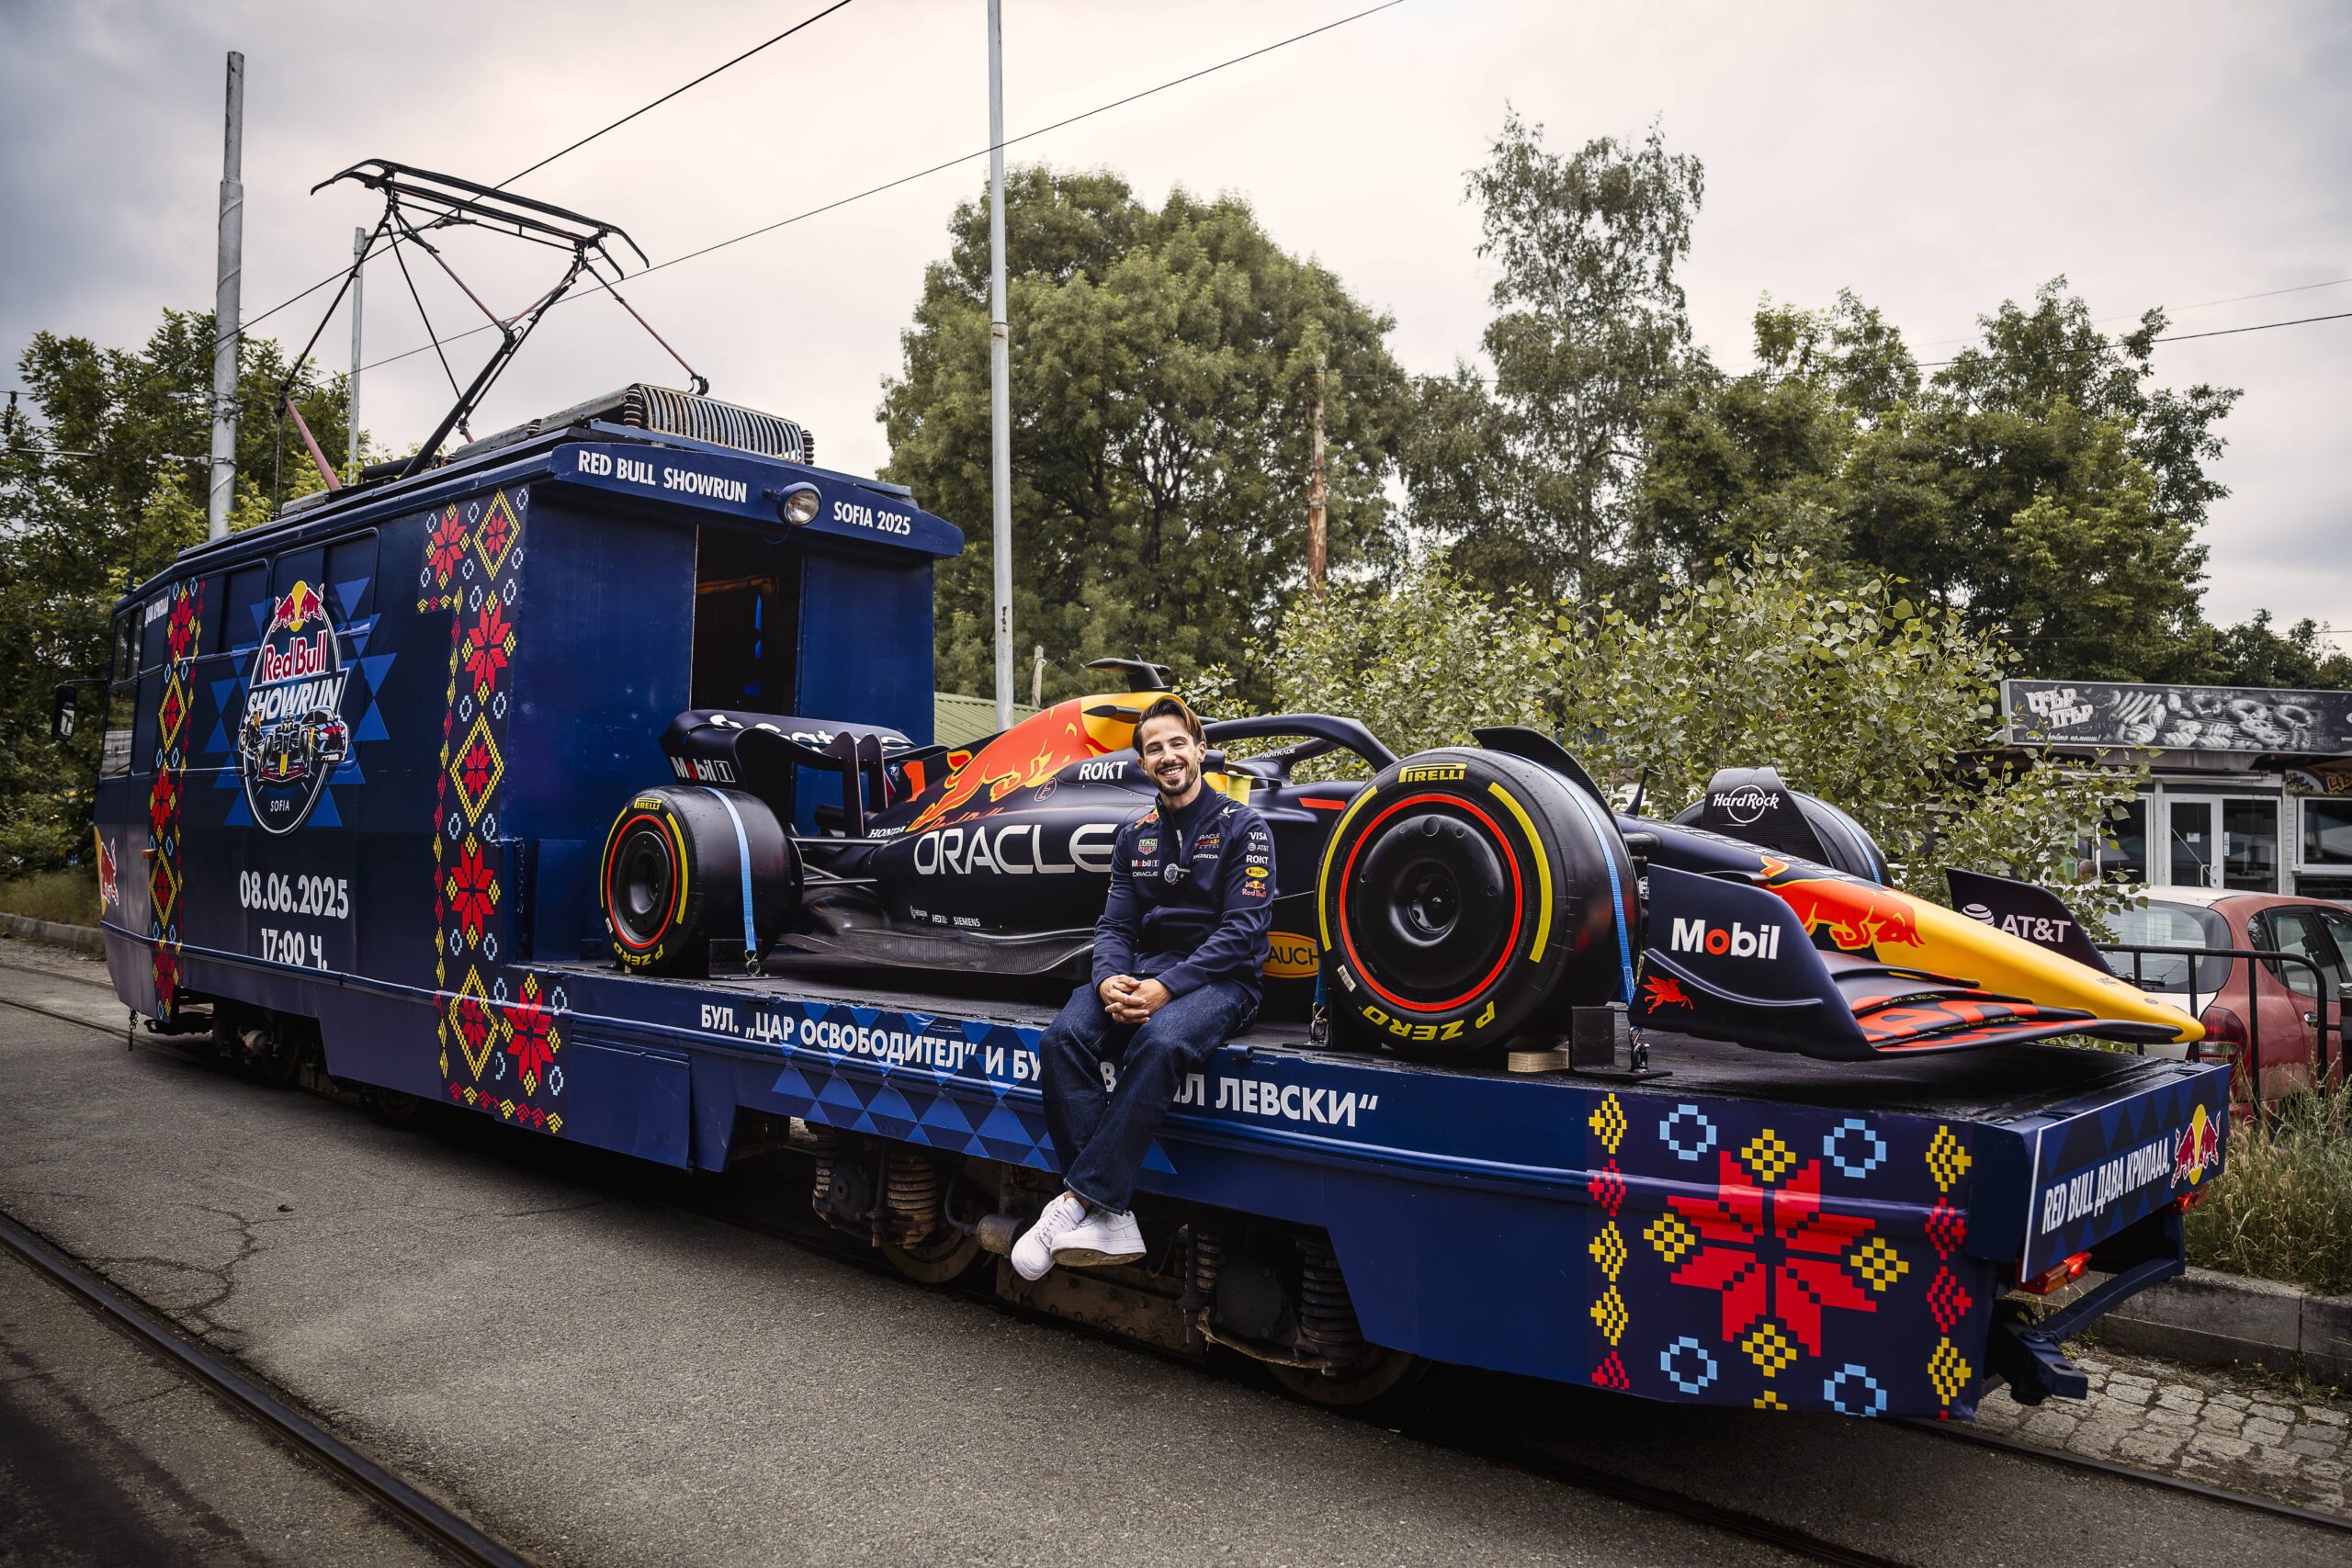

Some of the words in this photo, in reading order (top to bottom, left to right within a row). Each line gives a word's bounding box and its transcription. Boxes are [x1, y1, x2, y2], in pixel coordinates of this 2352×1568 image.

[578, 450, 612, 476] RED
[616, 457, 656, 486] BULL
[663, 467, 747, 503] SHOWRUN
[833, 501, 873, 528] SOFIA
[876, 510, 911, 536] 2025
[263, 637, 295, 682] Red
[295, 631, 327, 675] Bull
[243, 677, 343, 723] SHOWRUN
[671, 756, 718, 781] Mobil
[1078, 761, 1128, 781] ROKT
[1398, 763, 1467, 783] PIRELLI
[270, 800, 290, 812] SOFIA
[634, 797, 661, 811] PIRELLI
[1713, 793, 1746, 807] Hard
[1746, 793, 1779, 809] Rock
[867, 825, 906, 839] HONDA
[1197, 832, 1220, 840] RACLE
[1250, 831, 1268, 840] VISA
[914, 823, 1118, 874] ORACLE
[1246, 854, 1269, 864] ROKT
[1256, 844, 1269, 852] AT&T
[1132, 859, 1151, 867] Mobil
[240, 870, 349, 919] 08.06.2025
[1242, 888, 1255, 897] Red
[1256, 889, 1267, 898] Bull
[953, 916, 980, 927] SIEMENS
[2001, 914, 2071, 942] AT&T
[262, 928, 305, 966] 17:00
[1671, 918, 1781, 960] Mobil
[613, 942, 651, 966] ZERO
[655, 943, 663, 960] P
[1264, 945, 1319, 965] AUCH
[1362, 1005, 1464, 1041] ZERO
[1475, 1000, 1496, 1029] P
[701, 1004, 740, 1033] БУЛ.
[745, 1011, 795, 1043] „ЦАР
[985, 1045, 1005, 1076] И
[1012, 1050, 1041, 1081] БУ
[2041, 1182, 2067, 1235] RED
[2067, 1170, 2094, 1223] BULL
[2094, 1156, 2124, 1217] ДАВА
